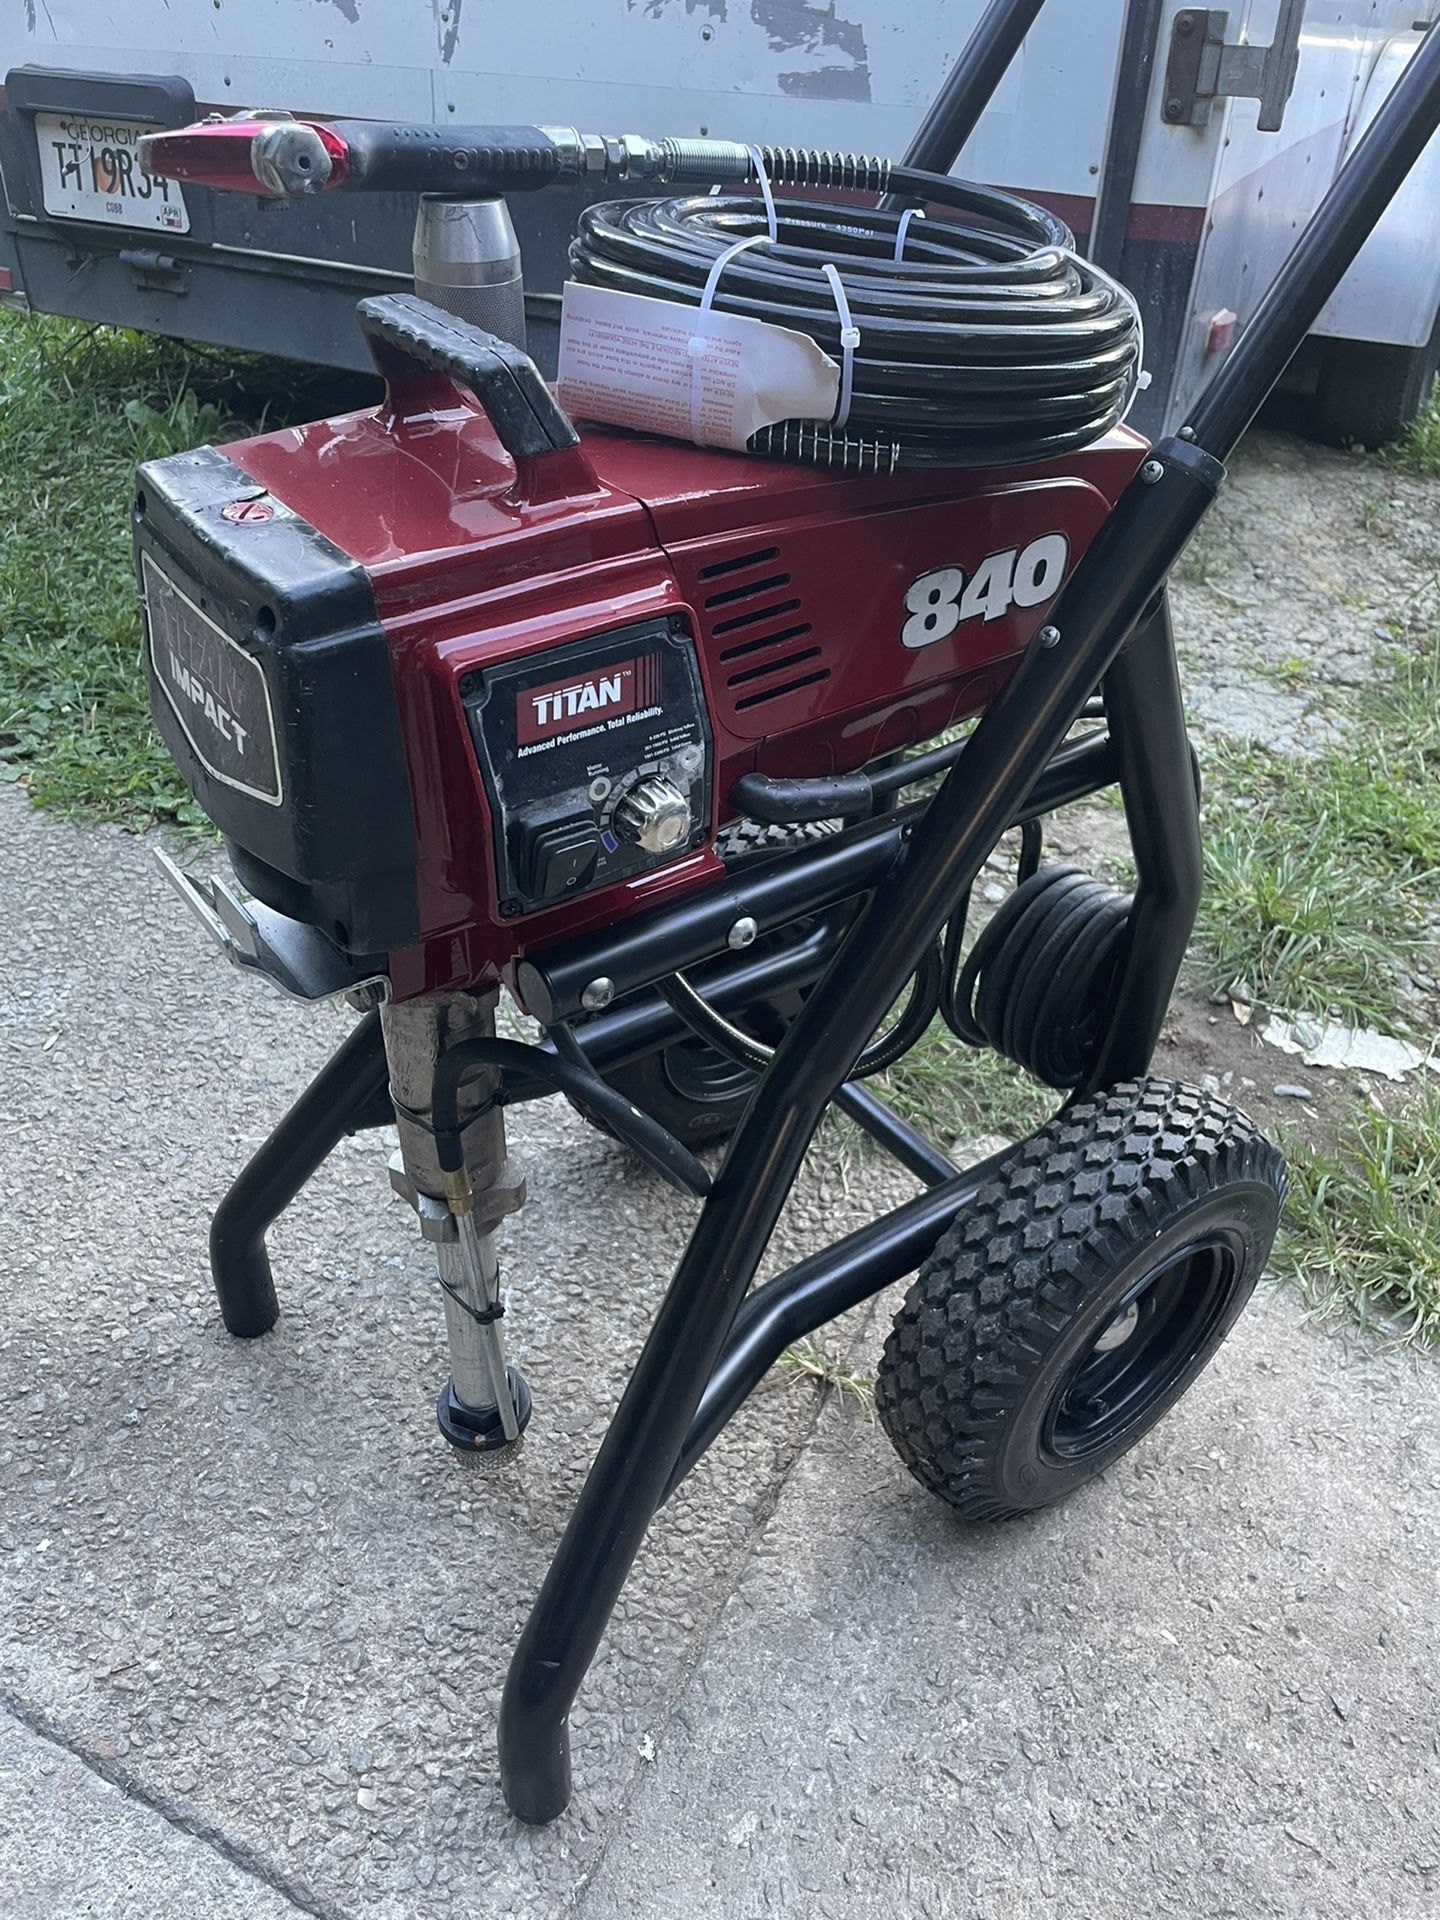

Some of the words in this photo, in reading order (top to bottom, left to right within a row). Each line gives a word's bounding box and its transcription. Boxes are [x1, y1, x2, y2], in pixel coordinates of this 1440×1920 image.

[67, 123, 142, 146] GEORGIA
[163, 207, 179, 218] APR
[785, 217, 827, 229] Pressure
[901, 534, 1068, 649] 840
[169, 650, 246, 755] IMPACT
[532, 673, 622, 726] TITAN
[517, 738, 555, 758] Advanced
[556, 724, 606, 746] Performance.
[607, 716, 625, 730] Total
[626, 705, 663, 725] Reliability.
